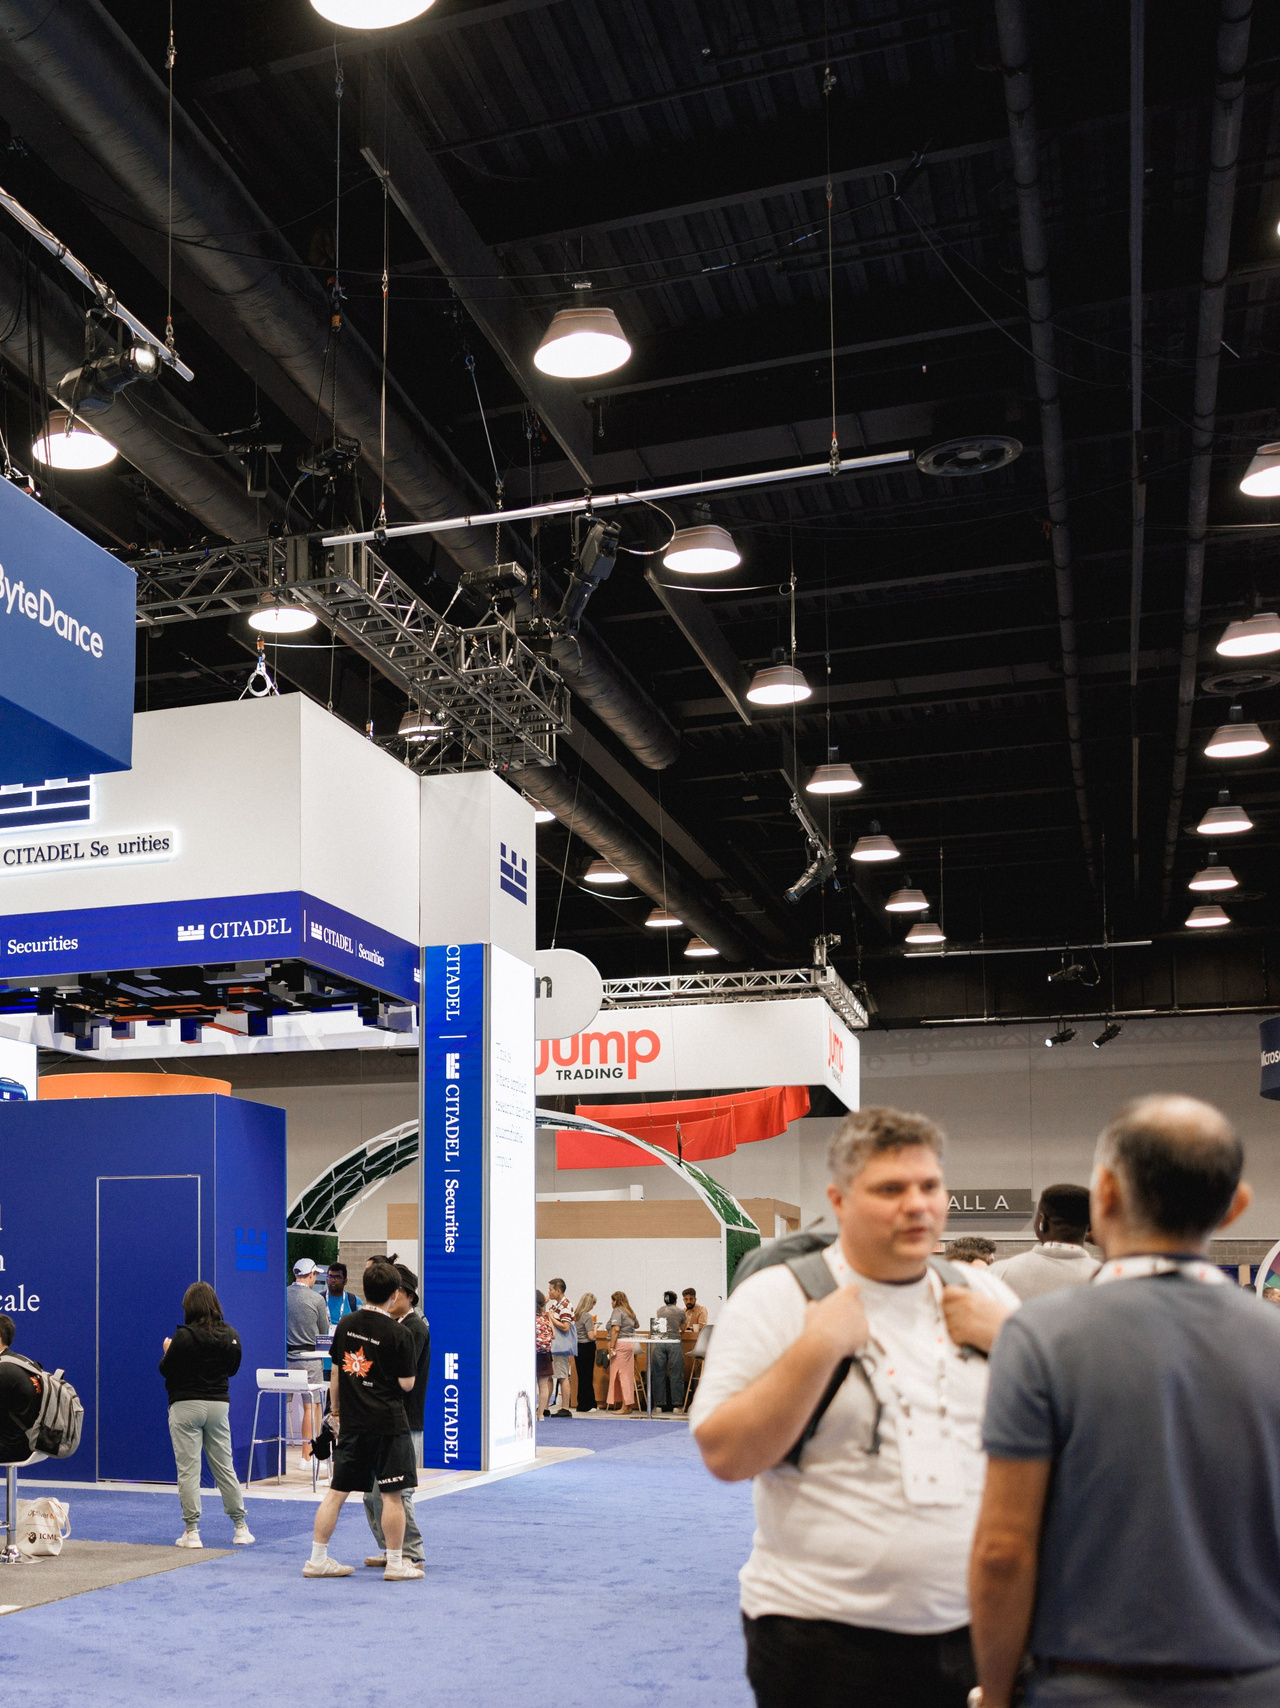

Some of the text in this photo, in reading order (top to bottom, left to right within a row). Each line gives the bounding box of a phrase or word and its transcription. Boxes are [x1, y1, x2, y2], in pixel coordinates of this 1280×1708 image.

[2, 842, 85, 866] CITADEL
[210, 918, 293, 940] CITADEL
[7, 935, 79, 956] Securities
[323, 927, 386, 969] CITADEL Securities
[446, 944, 461, 1021] CITADEL
[556, 1067, 624, 1080] TRADING
[445, 1084, 460, 1253] CITADEL Securities
[947, 1194, 1010, 1210] ALL A
[444, 1384, 459, 1464] CITADEL
[378, 1475, 404, 1484] AKLEY
[40, 1533, 57, 1541] ICML
